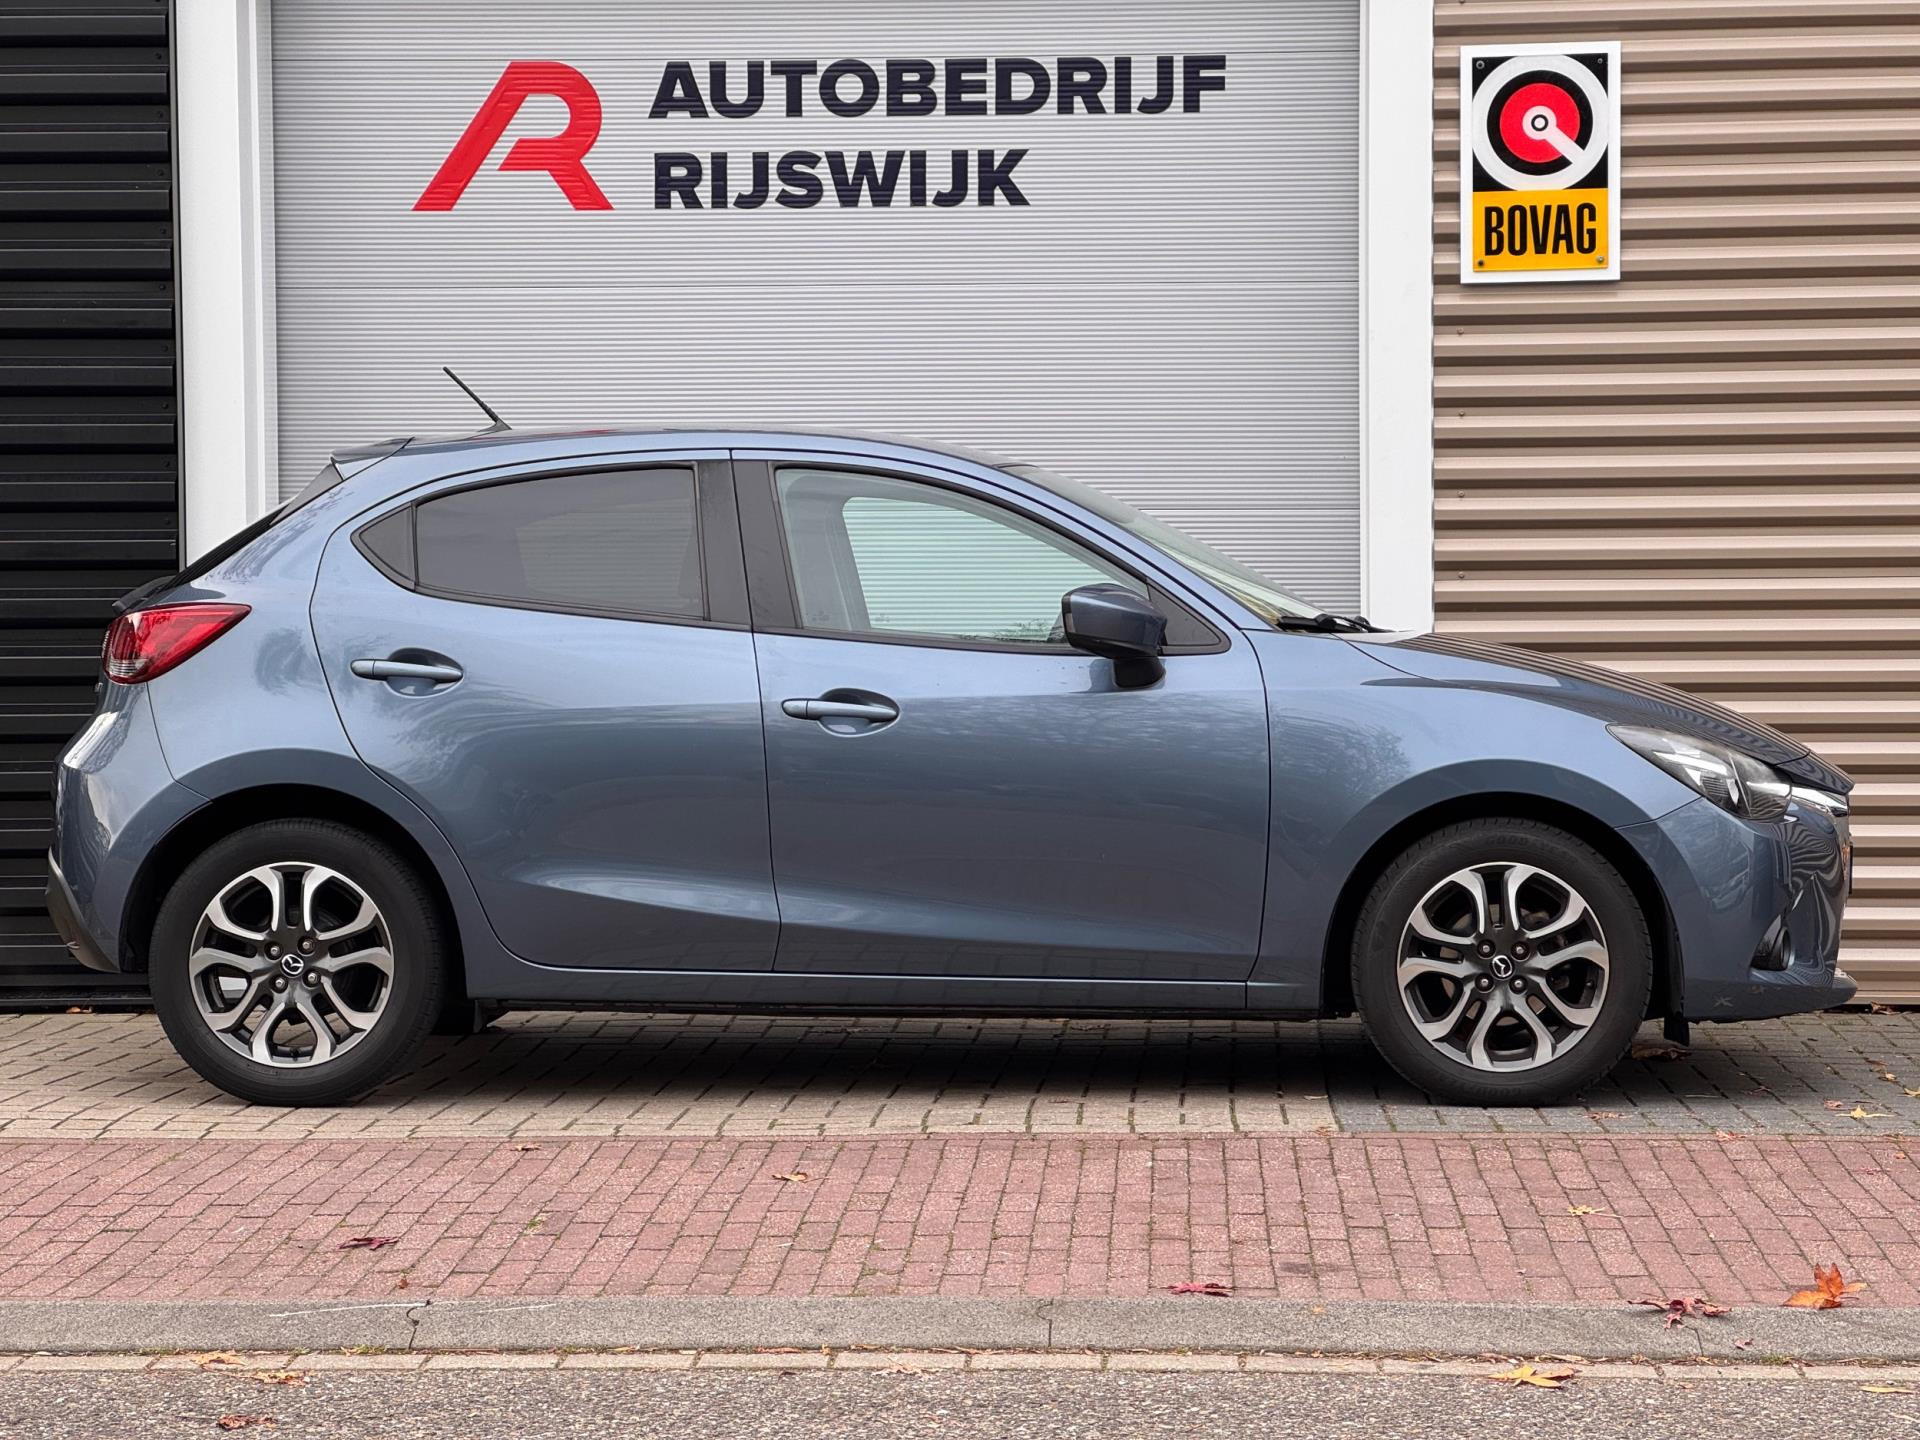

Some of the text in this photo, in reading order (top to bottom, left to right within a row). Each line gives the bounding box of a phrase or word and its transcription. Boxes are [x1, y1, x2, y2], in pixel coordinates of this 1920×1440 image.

[649, 55, 1226, 118] AUTOBEDRIJF
[655, 149, 1029, 209] RIJSWIJK
[1484, 203, 1597, 256] BOVAG
